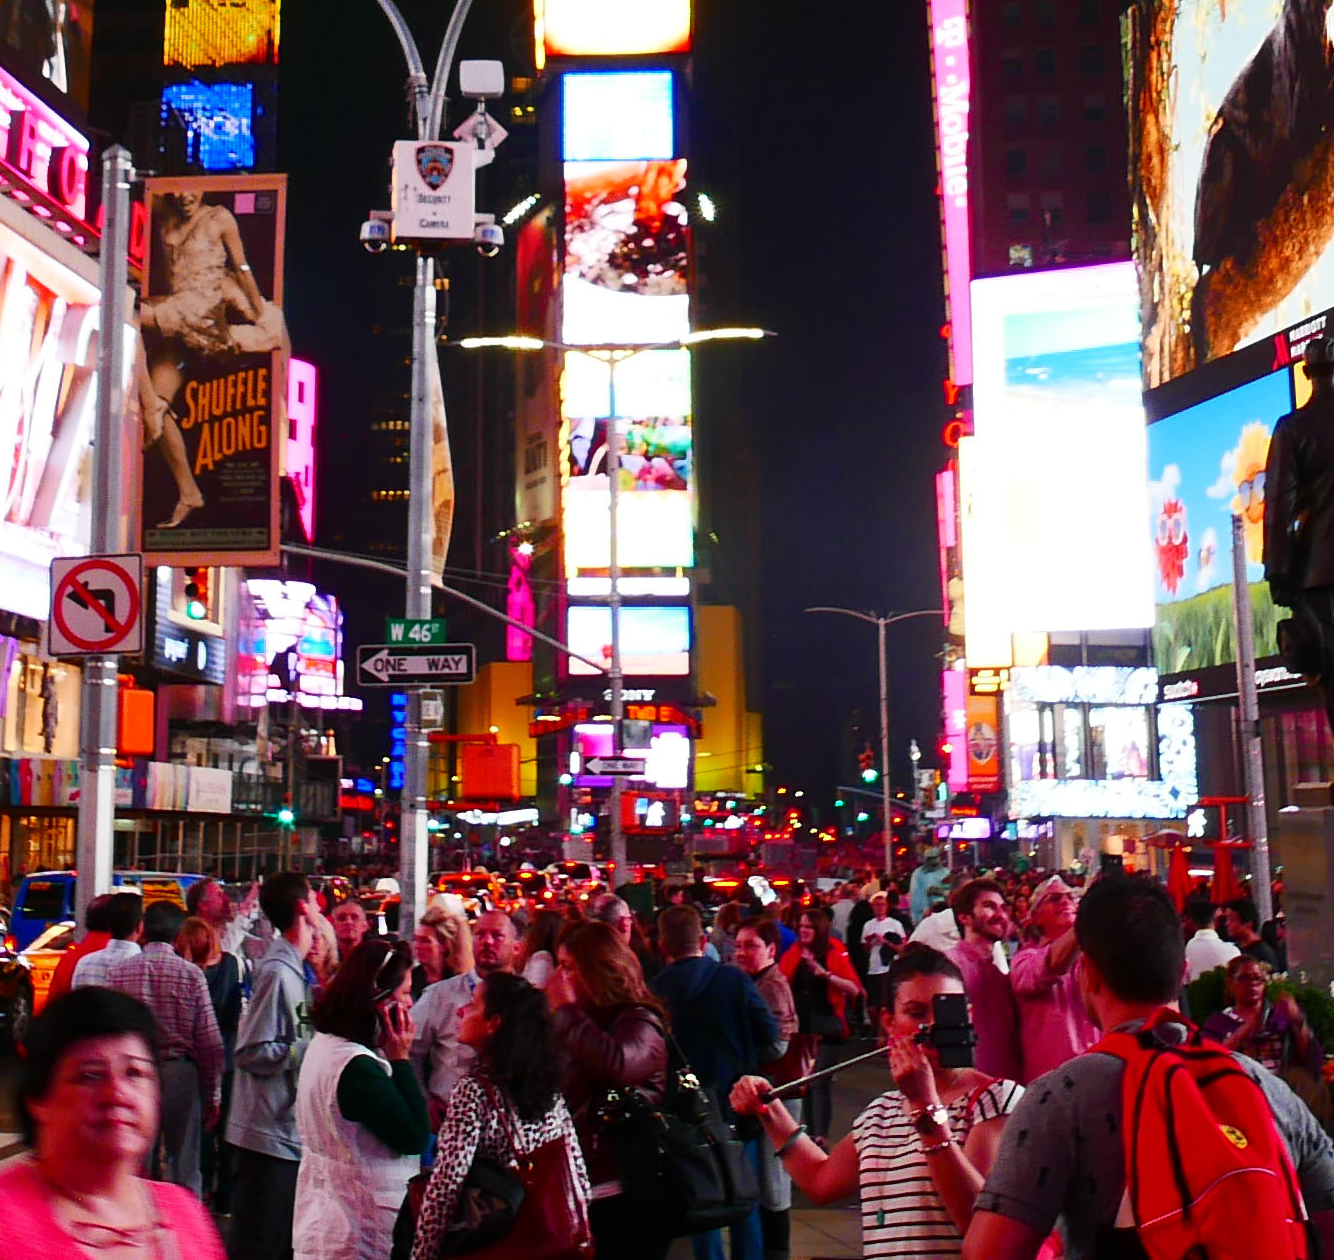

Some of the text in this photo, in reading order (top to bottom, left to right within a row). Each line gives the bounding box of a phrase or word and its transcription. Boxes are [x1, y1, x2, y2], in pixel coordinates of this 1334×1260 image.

[180, 367, 267, 430] SHUFFLE
[194, 410, 267, 476] ALONG
[390, 623, 404, 642] W
[373, 656, 463, 673] ONE WAY
